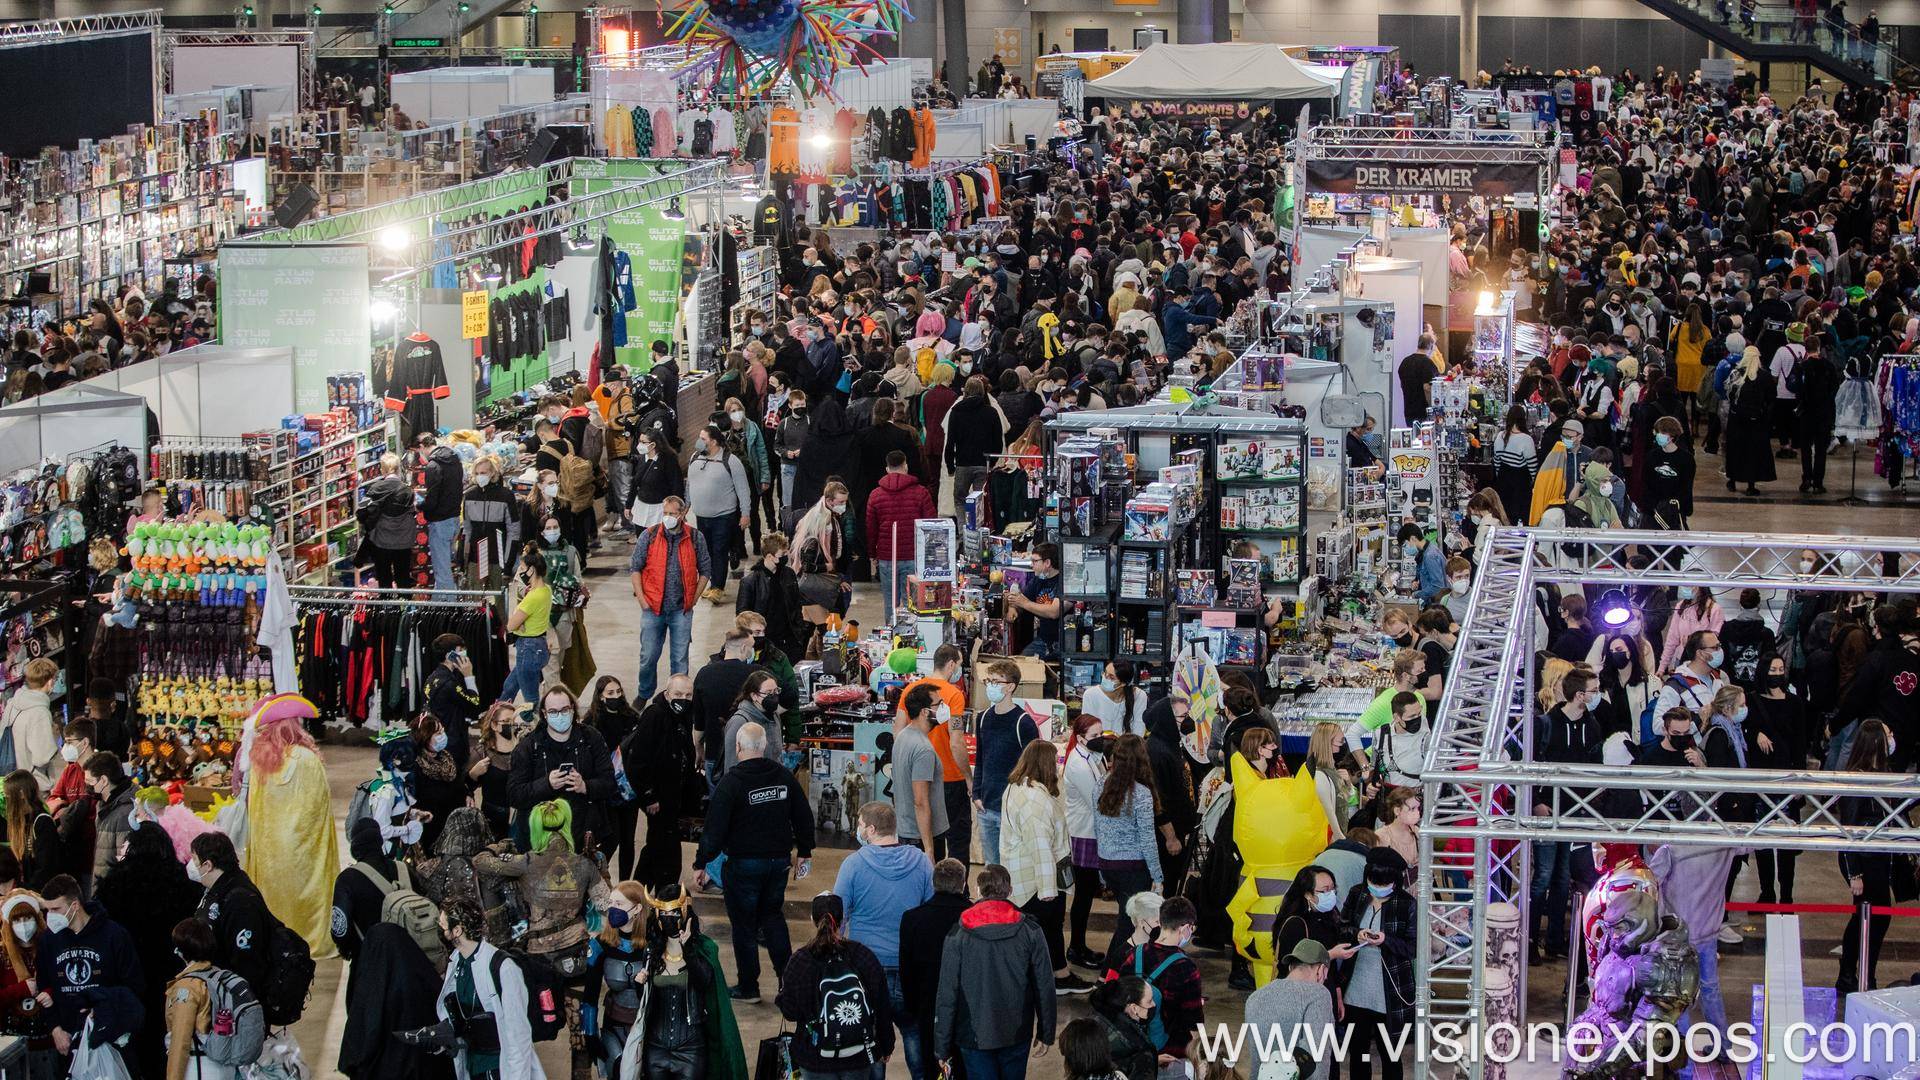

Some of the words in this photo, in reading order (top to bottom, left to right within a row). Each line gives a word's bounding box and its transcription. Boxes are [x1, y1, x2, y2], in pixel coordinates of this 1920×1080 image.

[1186, 103, 1234, 116] DONUTS
[1355, 167, 1391, 184] DER
[1391, 454, 1431, 473] POP!
[751, 789, 776, 800] around
[56, 949, 101, 965] HOGWARTS
